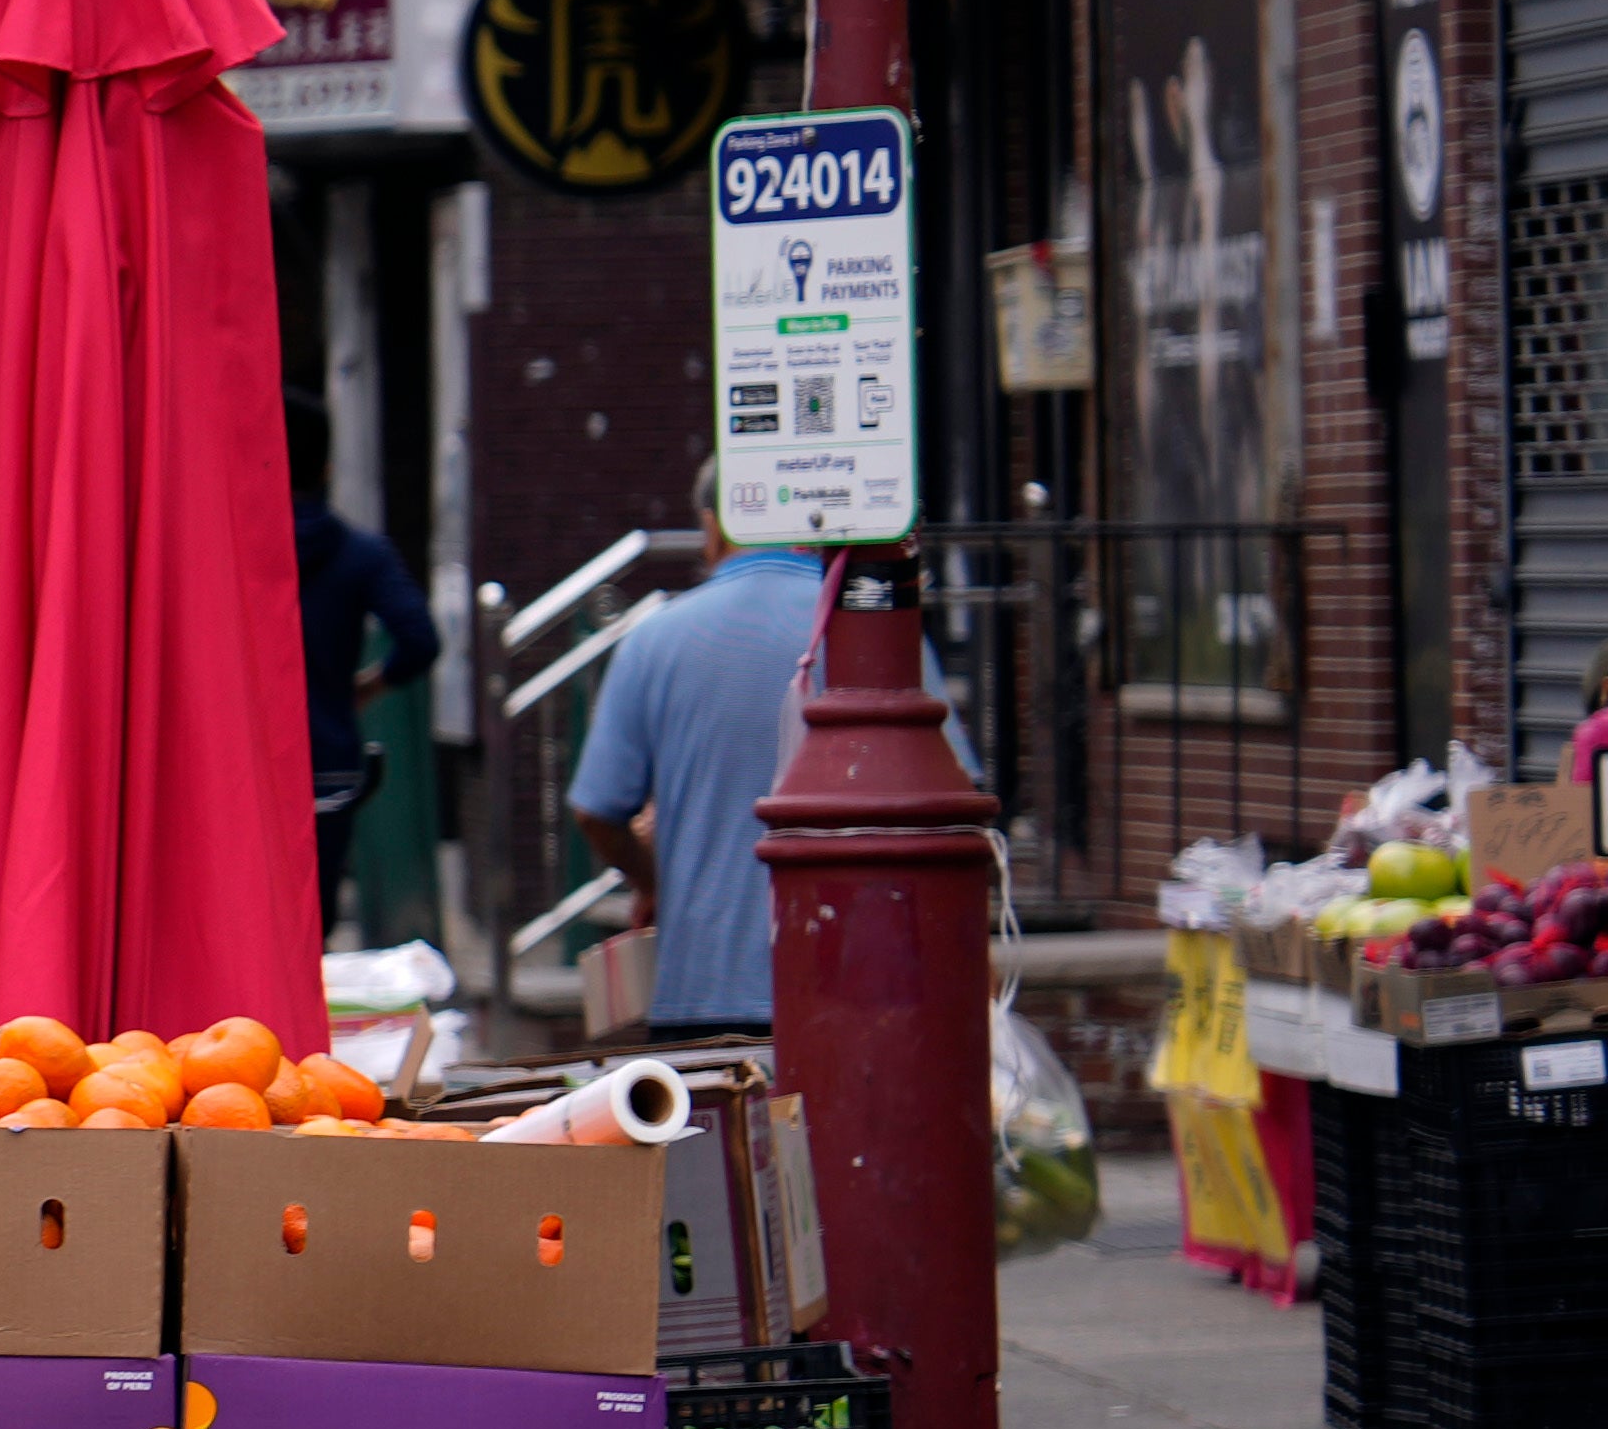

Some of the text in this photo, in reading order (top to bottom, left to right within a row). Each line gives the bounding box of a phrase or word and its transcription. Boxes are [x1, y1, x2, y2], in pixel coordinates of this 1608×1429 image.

[726, 146, 895, 216] 924014
[827, 255, 893, 276] PARKING
[821, 279, 900, 302] PAYMENTS
[104, 1370, 153, 1382] PRODUCE
[106, 1381, 152, 1392] OF PERU
[596, 1390, 646, 1403] PRODUCE
[597, 1401, 644, 1414] OF PERU
